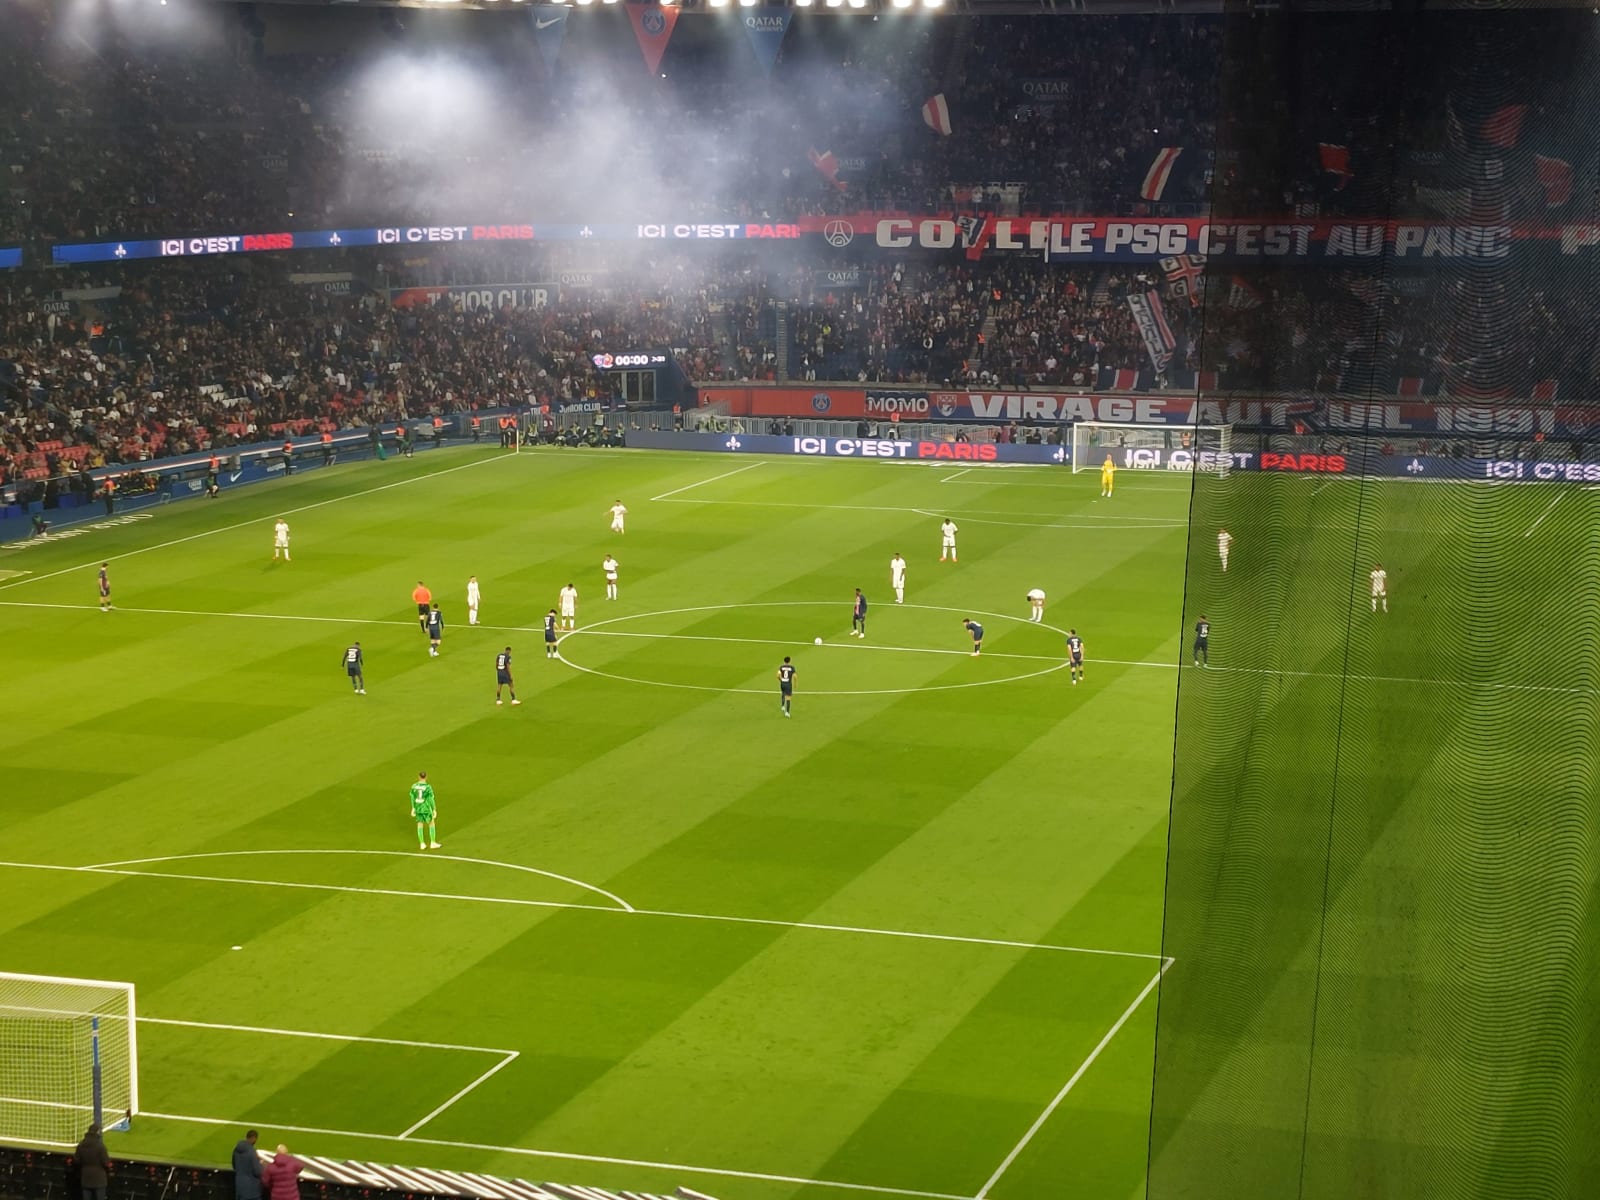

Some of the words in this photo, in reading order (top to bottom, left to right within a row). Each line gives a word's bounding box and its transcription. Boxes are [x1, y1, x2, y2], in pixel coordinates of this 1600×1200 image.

[745, 16, 784, 29] QATAR
[1022, 81, 1070, 96] QATAR
[376, 228, 401, 244] ICI
[406, 226, 468, 243] C'EST
[471, 225, 535, 241] PARIS
[637, 224, 666, 239] ICI
[673, 224, 740, 239] C'EST
[161, 241, 185, 256] ICI
[189, 236, 241, 253] C'EST
[242, 233, 294, 251] PARIS
[1051, 222, 1096, 254] LE
[1104, 222, 1189, 255] PSG
[1198, 224, 1315, 256] C'EST
[1324, 224, 1384, 257] AU
[1394, 225, 1512, 257] PARC
[561, 273, 593, 285] QATAR
[827, 271, 859, 282] QATAR
[324, 282, 351, 292] QATAR
[43, 301, 70, 312] QATAR
[615, 355, 648, 366] 00:00
[868, 397, 929, 413] MOMO
[969, 395, 1168, 422] VIRAGE
[793, 437, 826, 455] ICI
[835, 440, 912, 458] C'EST
[918, 441, 998, 460] PARIS
[1126, 449, 1161, 465] ICI
[1170, 450, 1254, 470] C'EST
[1260, 452, 1346, 473] PARIS
[1486, 460, 1524, 479] ICI
